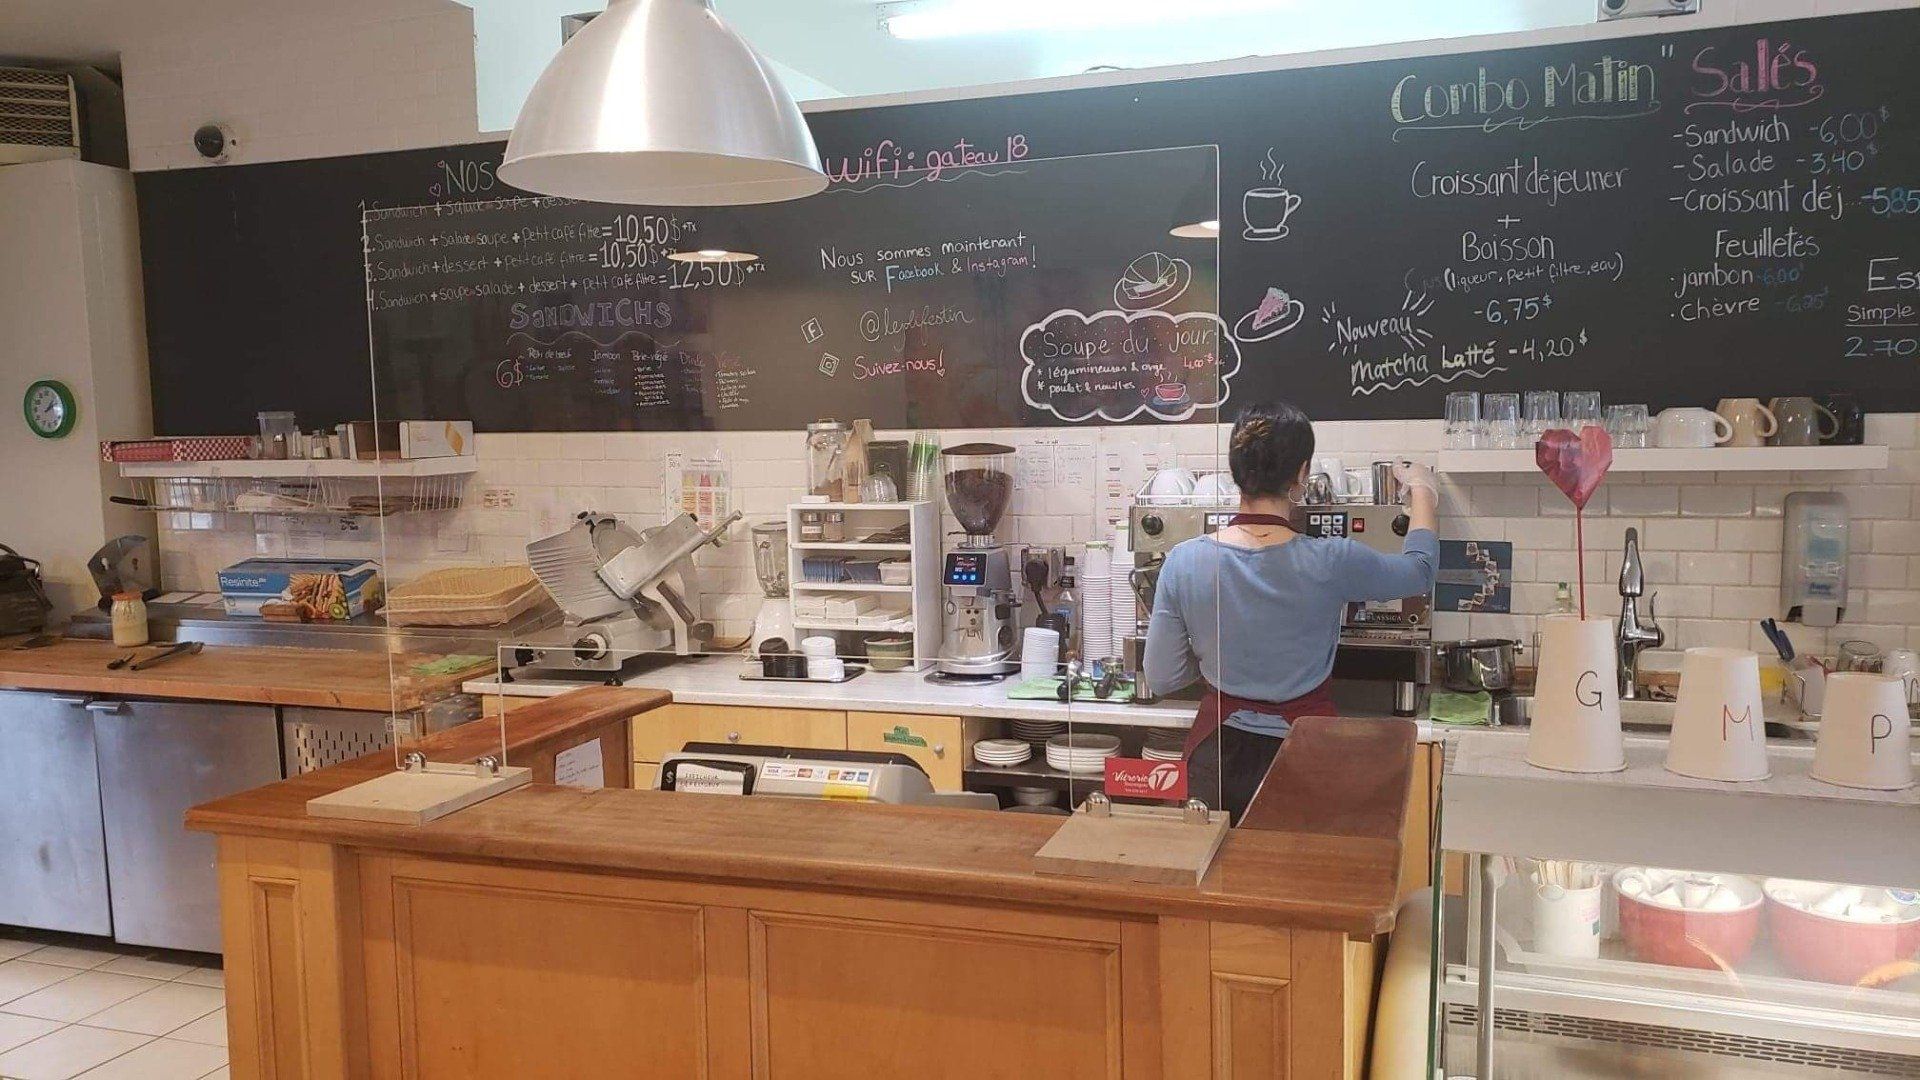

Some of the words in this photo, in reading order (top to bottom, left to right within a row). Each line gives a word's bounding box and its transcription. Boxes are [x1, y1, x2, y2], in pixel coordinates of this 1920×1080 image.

[1692, 38, 1817, 97] Salés
[1391, 74, 1530, 123] Combo
[1007, 134, 1029, 162] 18
[445, 160, 494, 193] NOS
[1412, 158, 1523, 197] Croissant
[1526, 156, 1630, 206] déjeuner
[821, 247, 864, 270] Nous
[877, 245, 931, 262] sommes
[942, 230, 1026, 254] maintenant
[1462, 231, 1554, 261] Boisson
[1715, 227, 1821, 258] Feuilletés
[529, 276, 567, 294] dessert
[886, 263, 944, 293] Facebook
[951, 258, 963, 274] &
[1337, 313, 1412, 344] Nouveau
[1848, 304, 1916, 326] Simple
[1043, 332, 1111, 359] Soupe
[1123, 330, 1149, 355] du
[1049, 381, 1083, 397] poulet
[1095, 381, 1135, 392] nouilles
[1575, 671, 1602, 711] G
[1723, 704, 1754, 741] M
[1871, 714, 1892, 754] P
